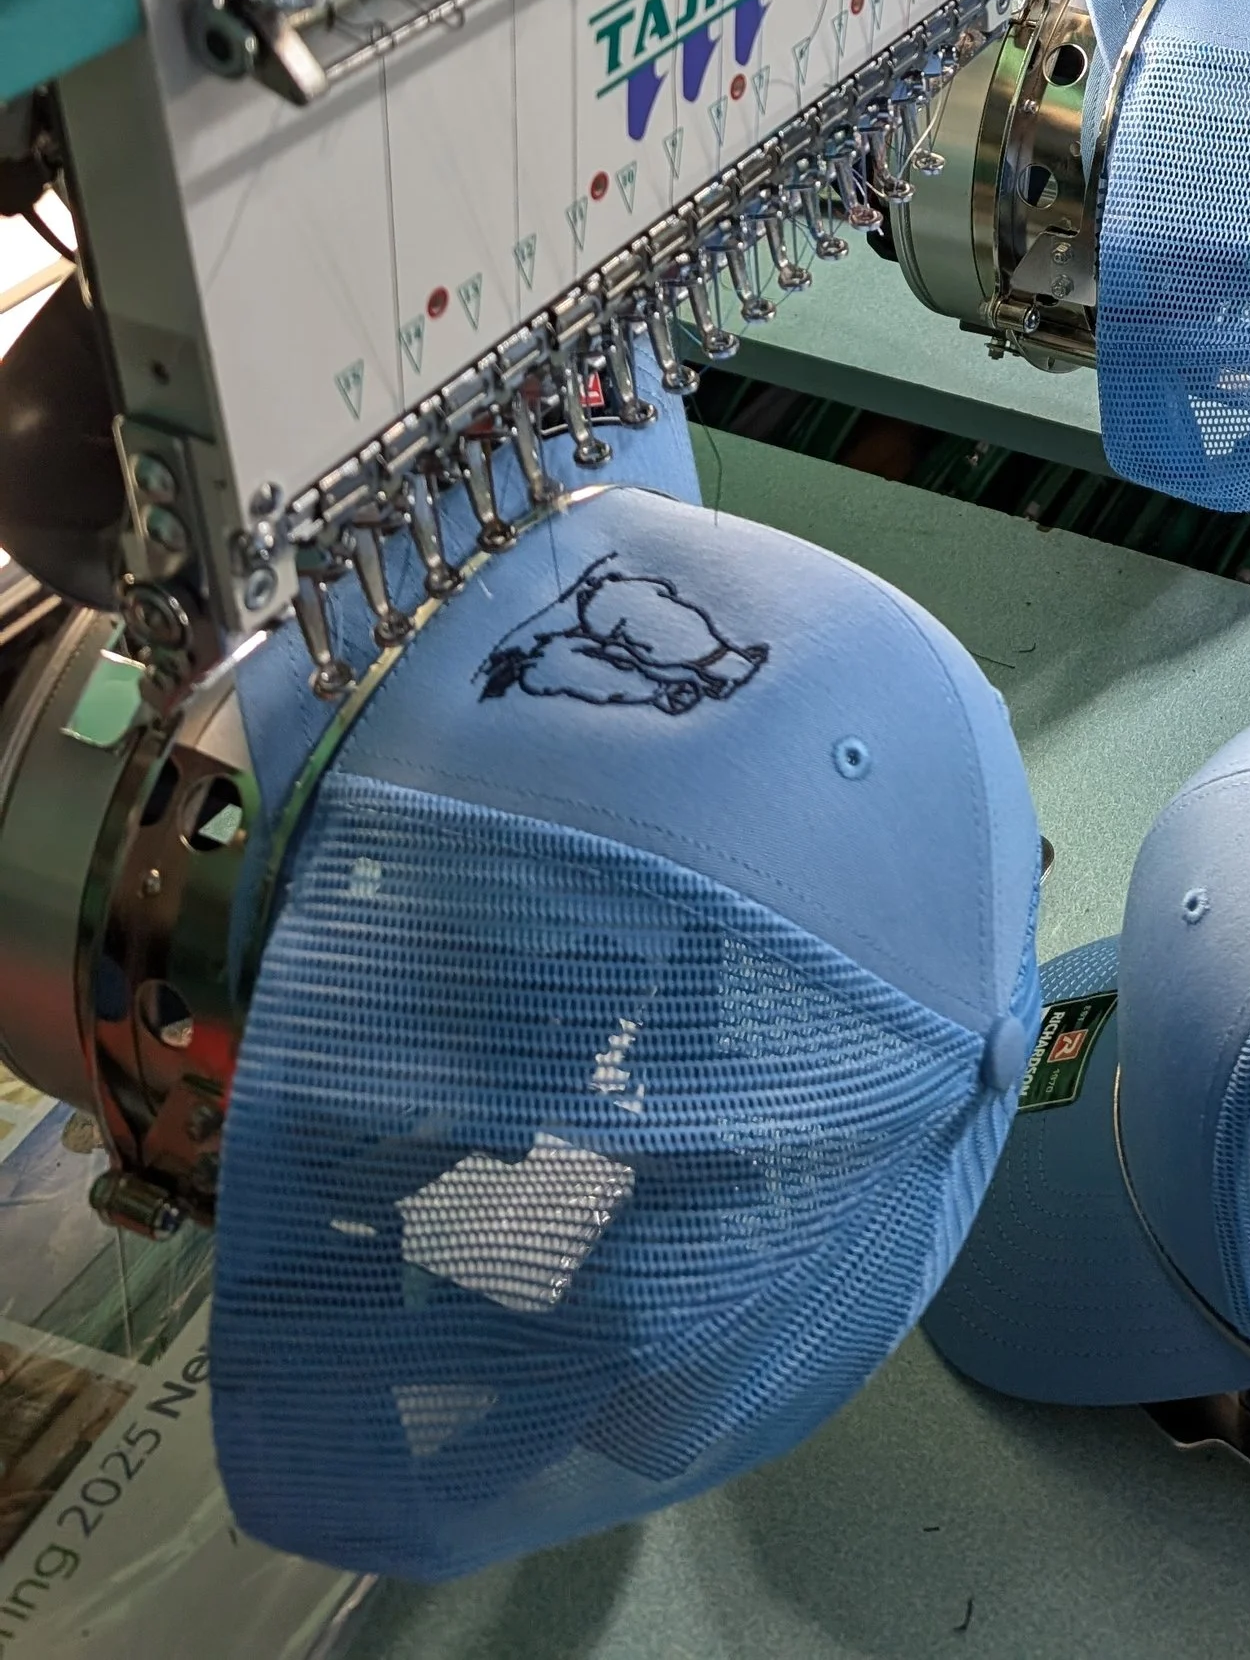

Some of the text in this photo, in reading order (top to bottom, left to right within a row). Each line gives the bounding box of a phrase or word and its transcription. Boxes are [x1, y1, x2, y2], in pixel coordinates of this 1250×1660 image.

[1018, 1011, 1066, 1097] RICHARDSON
[56, 1421, 162, 1539] 2025
[145, 1344, 211, 1421] Ne
